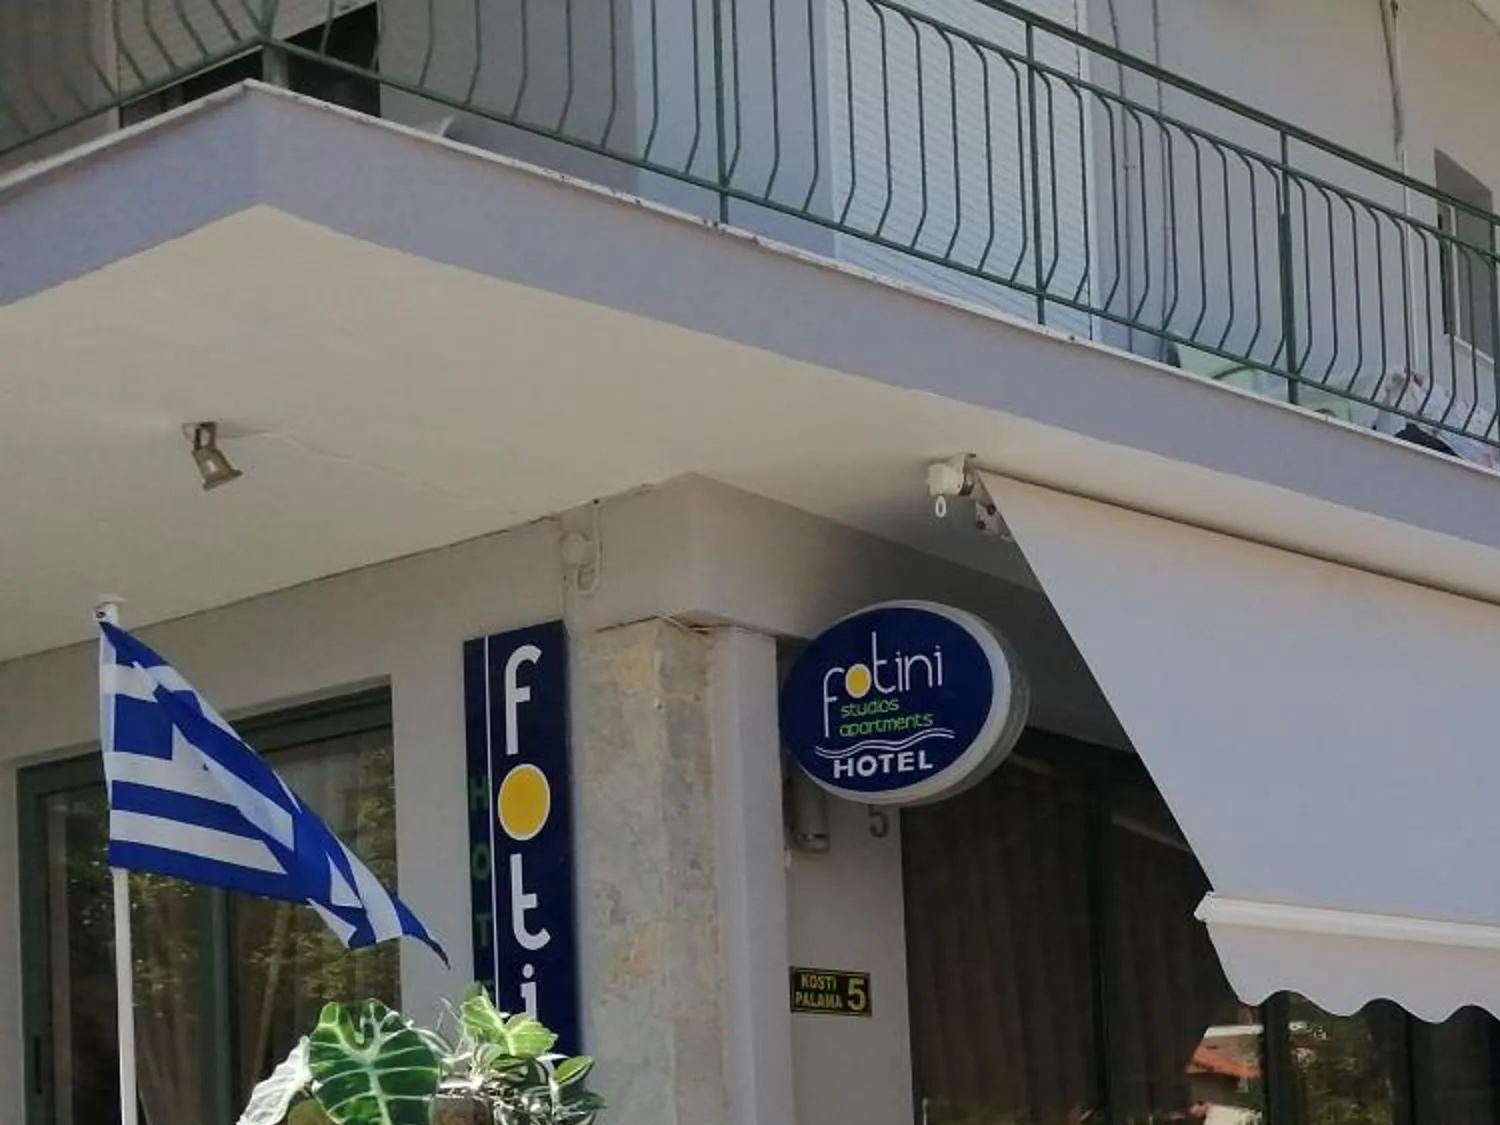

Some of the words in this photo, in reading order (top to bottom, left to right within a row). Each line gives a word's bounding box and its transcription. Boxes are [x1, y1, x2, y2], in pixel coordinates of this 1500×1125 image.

[822, 630, 944, 739] fotini
[840, 697, 900, 718] studios
[839, 713, 935, 738] apartments
[833, 750, 934, 779] HOTEL
[801, 973, 838, 991] KOSTI
[847, 978, 867, 1011] 5
[794, 991, 843, 1009] PALAMA
